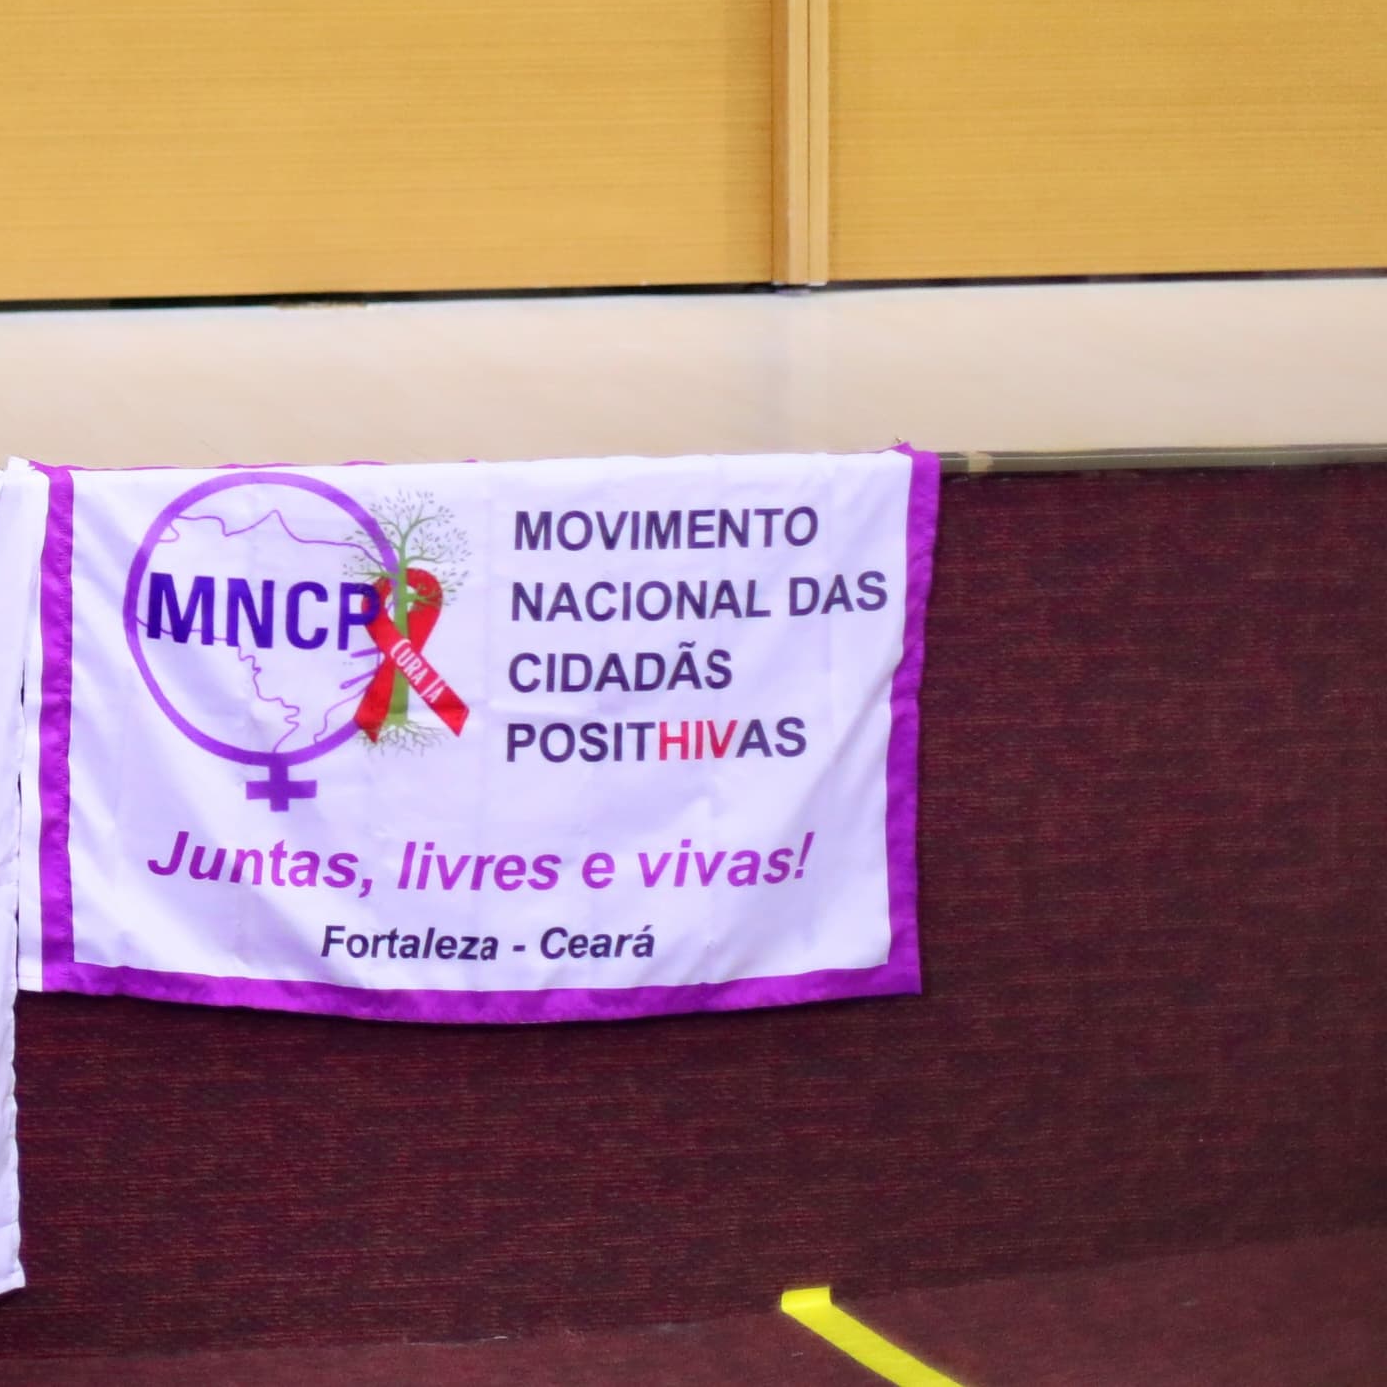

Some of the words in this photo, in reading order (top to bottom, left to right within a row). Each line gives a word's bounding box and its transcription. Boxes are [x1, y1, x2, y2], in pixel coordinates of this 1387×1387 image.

[513, 506, 818, 551] MOVIMENTO
[147, 572, 381, 651] MNCP
[511, 580, 770, 622] NACIONAL
[788, 571, 888, 615] DAS
[390, 638, 428, 687] CURA
[509, 640, 733, 693] CIDADÃS
[506, 717, 807, 763] POSITHIVAS
[147, 830, 374, 900] Juntas,
[397, 841, 559, 891] livres
[581, 851, 616, 890] e
[638, 831, 815, 888] vivas!
[321, 924, 500, 962] Fortaleza
[540, 924, 655, 959] Ceará
